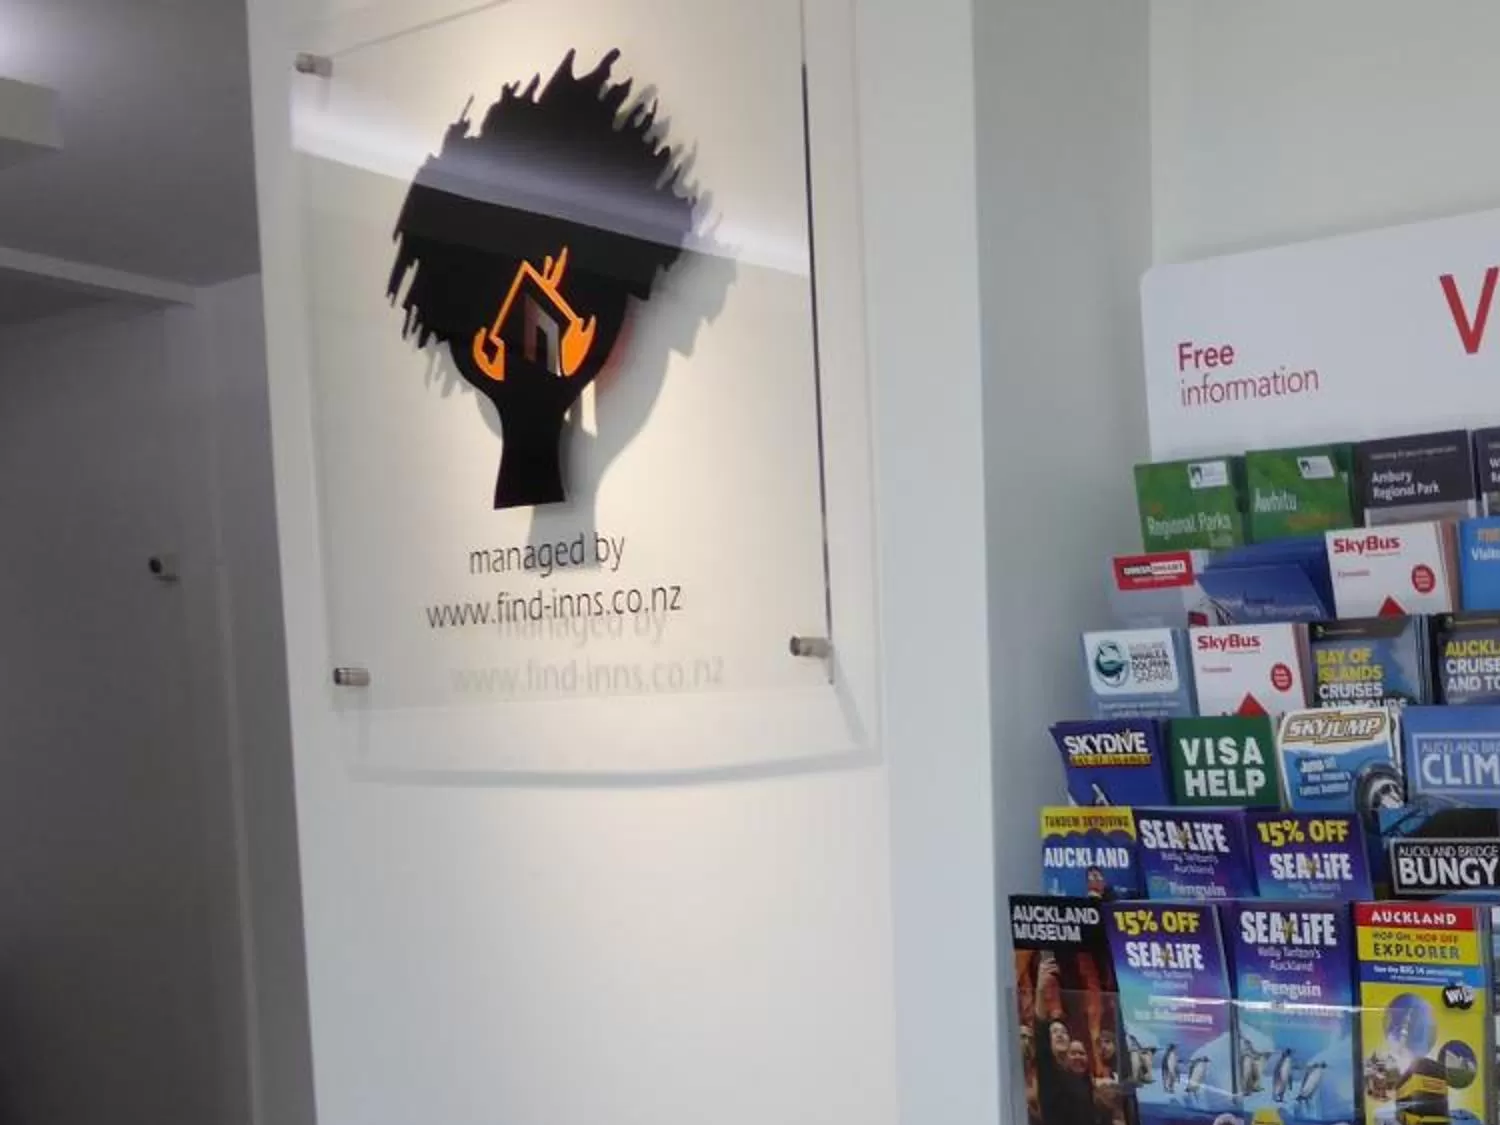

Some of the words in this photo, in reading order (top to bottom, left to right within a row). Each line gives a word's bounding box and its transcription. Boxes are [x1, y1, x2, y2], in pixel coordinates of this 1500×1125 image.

[1177, 339, 1235, 371] Free
[1179, 364, 1320, 407] information
[1373, 483, 1415, 501] Regional
[1417, 480, 1440, 495] Park
[469, 533, 585, 576] managed
[593, 530, 626, 572] by
[1333, 535, 1400, 557] SkyBus
[426, 582, 683, 629] www.find-inns.co.nz
[1197, 632, 1261, 651] SkyBus
[1316, 649, 1348, 665] BAY
[1351, 647, 1371, 663] OF
[1317, 664, 1385, 682] ISLANDS
[1447, 674, 1483, 692] AND
[1319, 681, 1384, 699] CRUISES
[1286, 717, 1381, 740] SKYJUMP
[1062, 730, 1149, 755] SKYDIVE
[1180, 736, 1265, 767] VISA
[1184, 768, 1267, 797] HELP
[1045, 814, 1077, 829] TANDEM
[1256, 820, 1304, 847] 15%
[1308, 819, 1349, 844] OFF
[1044, 845, 1130, 869] AUCKLAND
[1400, 845, 1453, 858] AUCKLAND
[1456, 844, 1499, 858] BRIDGE
[1399, 856, 1499, 888] BUNGY
[1013, 904, 1100, 927] AUCKLAND
[1113, 910, 1159, 935] 15%
[1162, 910, 1200, 933] OFF
[1371, 909, 1457, 926] AUCKLAND
[1013, 923, 1082, 943] MUSEUM
[1372, 942, 1460, 961] EXPLORER
[1262, 980, 1322, 999] Penguin
